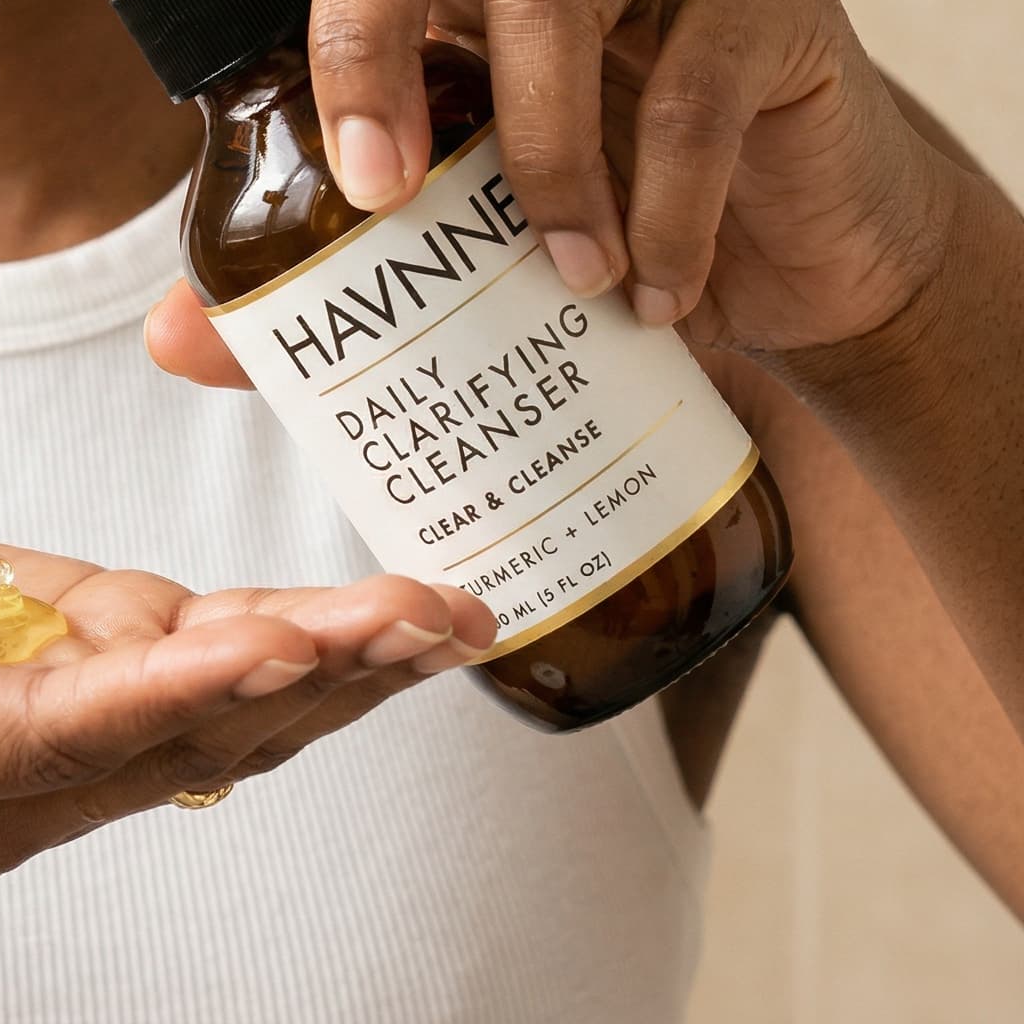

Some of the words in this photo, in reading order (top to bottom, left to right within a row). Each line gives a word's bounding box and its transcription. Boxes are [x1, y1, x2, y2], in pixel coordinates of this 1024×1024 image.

[272, 173, 528, 379] HAVNNE
[335, 356, 445, 441] DAILY
[362, 304, 588, 471] CLARIFYING
[386, 360, 590, 504] CLEANSER
[418, 504, 482, 545] CLEAR
[484, 491, 505, 511] &
[508, 419, 603, 494] CLEANSE
[460, 536, 558, 596] URMERIC
[566, 526, 578, 539] +
[584, 463, 658, 527] LEMON
[512, 600, 537, 621] ML
[557, 576, 578, 593] FL
[580, 551, 612, 578] OZ)
